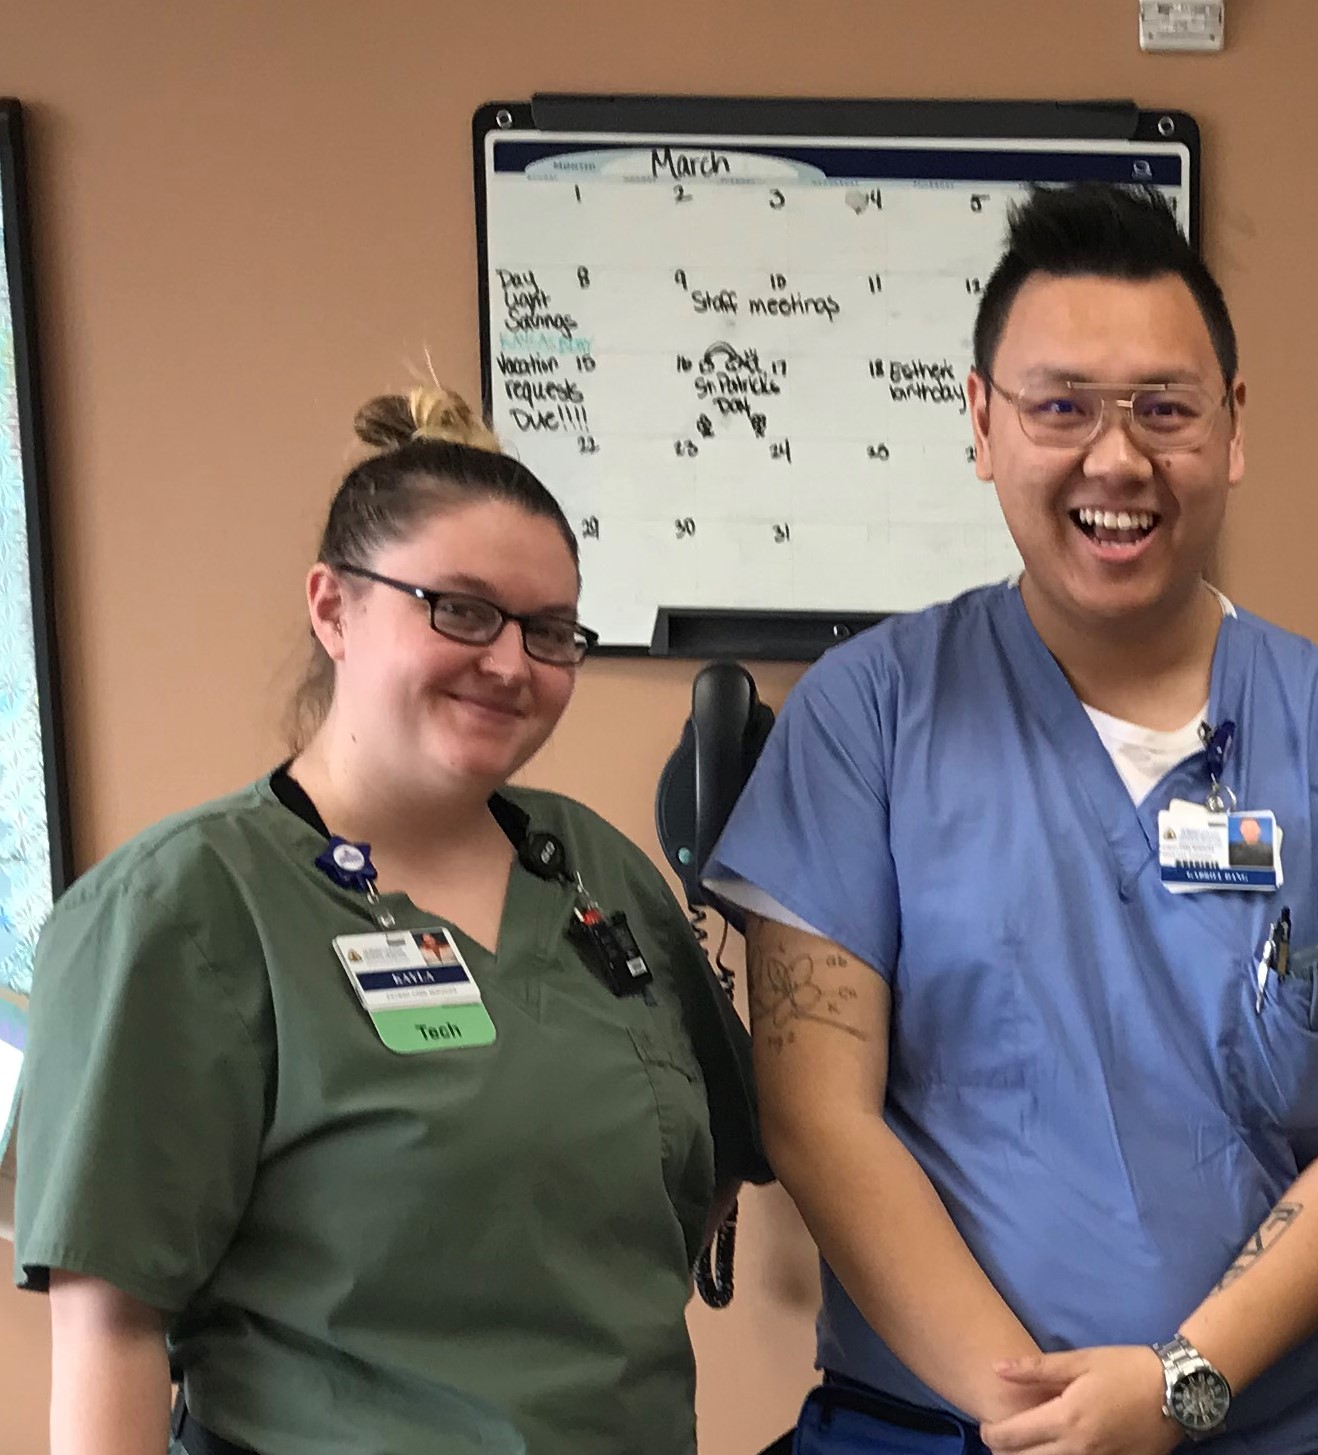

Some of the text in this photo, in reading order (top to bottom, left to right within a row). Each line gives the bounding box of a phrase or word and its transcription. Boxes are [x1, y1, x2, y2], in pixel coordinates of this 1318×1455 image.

[650, 146, 730, 180] March
[574, 184, 582, 204] 1
[673, 185, 693, 204] 2
[769, 188, 786, 210] 3
[869, 188, 882, 210] 4
[970, 193, 991, 214] 5
[497, 268, 539, 292] Day
[577, 265, 590, 289] 8
[674, 268, 689, 291] 9
[770, 273, 787, 290] 10
[869, 274, 882, 295] 11
[691, 289, 841, 323] Staff meetings
[771, 358, 787, 377] 17
[868, 358, 884, 379] 18
[504, 378, 585, 408] requests
[577, 436, 600, 455] 22
[769, 438, 793, 464] 24
[581, 516, 600, 541] 29
[674, 517, 696, 540] 30
[772, 523, 791, 543] 31
[393, 970, 435, 987] KAYLA
[415, 1021, 463, 1042] Tech
